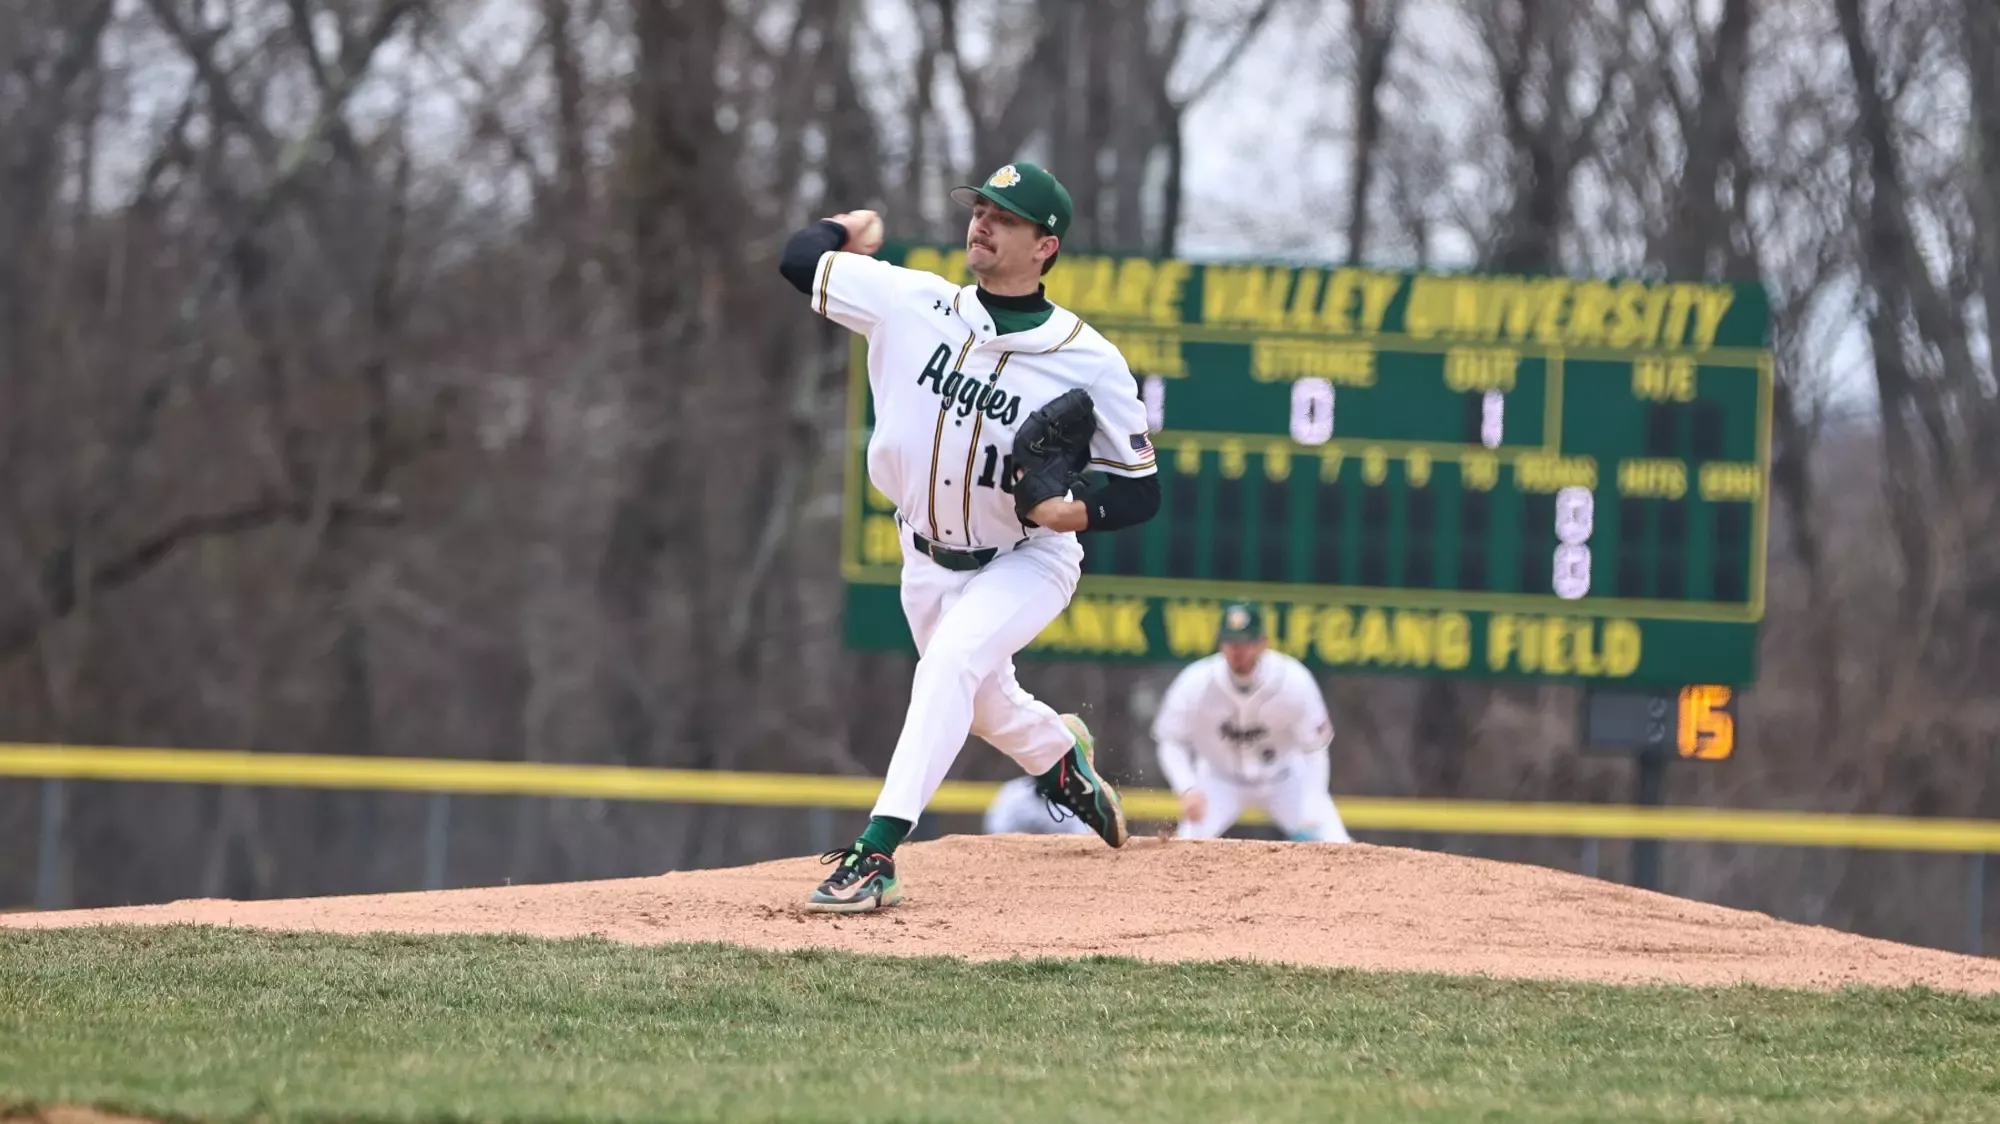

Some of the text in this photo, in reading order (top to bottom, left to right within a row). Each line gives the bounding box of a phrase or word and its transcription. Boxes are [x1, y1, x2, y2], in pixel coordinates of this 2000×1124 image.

[1203, 263, 1397, 334] VALLEY
[1405, 273, 1734, 352] UNIVERSITY
[917, 342, 1021, 426] Aggies
[1290, 376, 1335, 446] 0
[1162, 601, 1471, 670] WLFGANG
[1486, 613, 1642, 678] FIELD
[1677, 685, 1734, 760] 15
